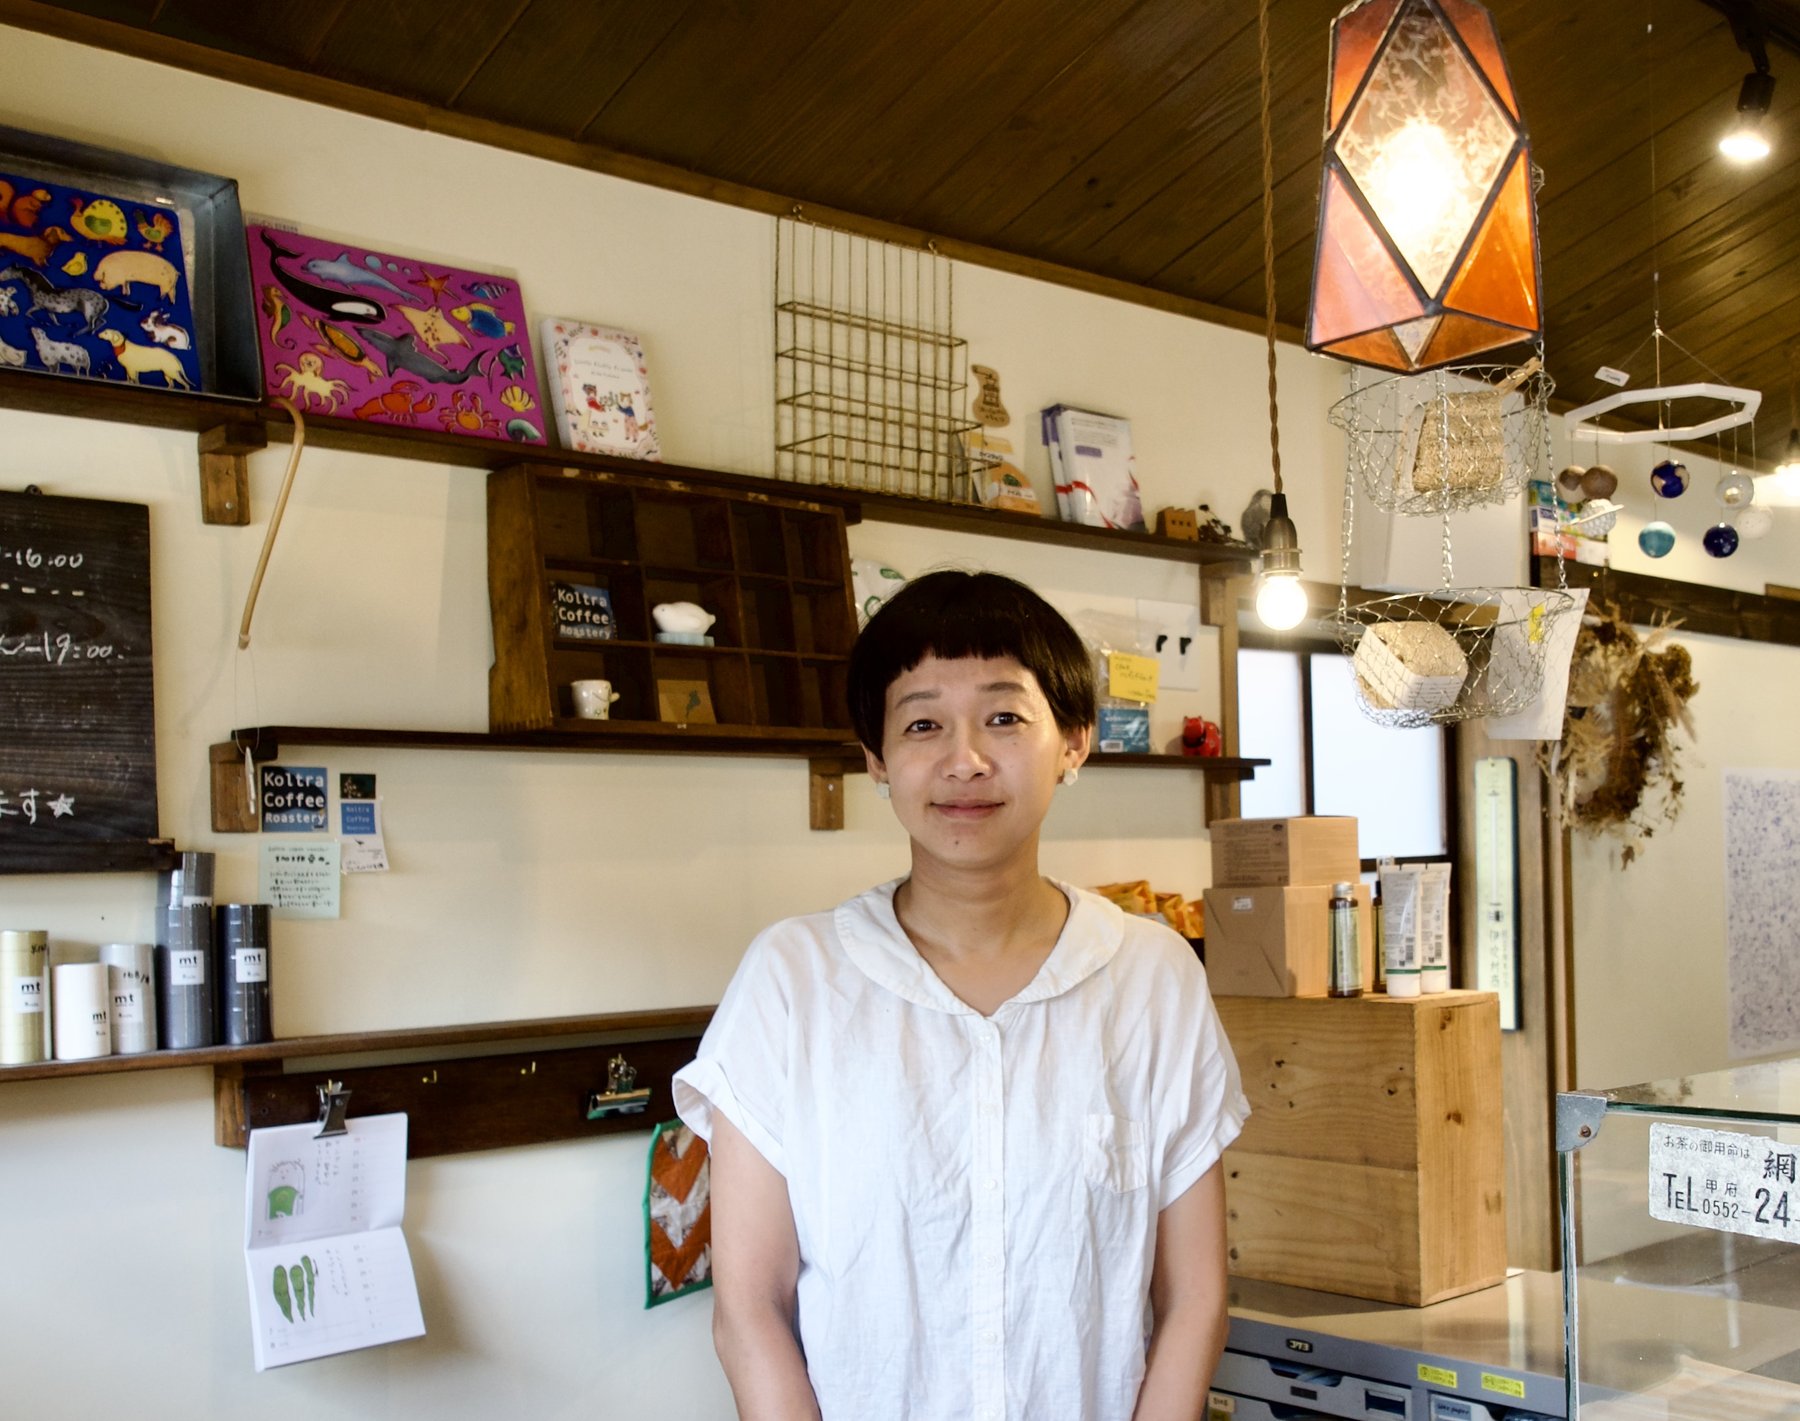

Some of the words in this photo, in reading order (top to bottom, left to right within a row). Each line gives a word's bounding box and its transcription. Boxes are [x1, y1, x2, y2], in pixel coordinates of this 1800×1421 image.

[557, 589, 608, 608] Koltra
[558, 607, 609, 625] Coffee
[559, 624, 611, 640] Roastery
[264, 772, 325, 788] Koltra
[264, 793, 325, 808] Coffee
[265, 813, 326, 825] Roastery
[179, 955, 198, 966] mt
[244, 953, 262, 963] mt
[21, 982, 41, 993] mt
[114, 993, 135, 1004] mt
[92, 1011, 107, 1021] mt
[1663, 1135, 1750, 1159] お茶の御用命は
[1663, 1172, 1699, 1212] TEL
[1705, 1179, 1738, 1198] 甲府
